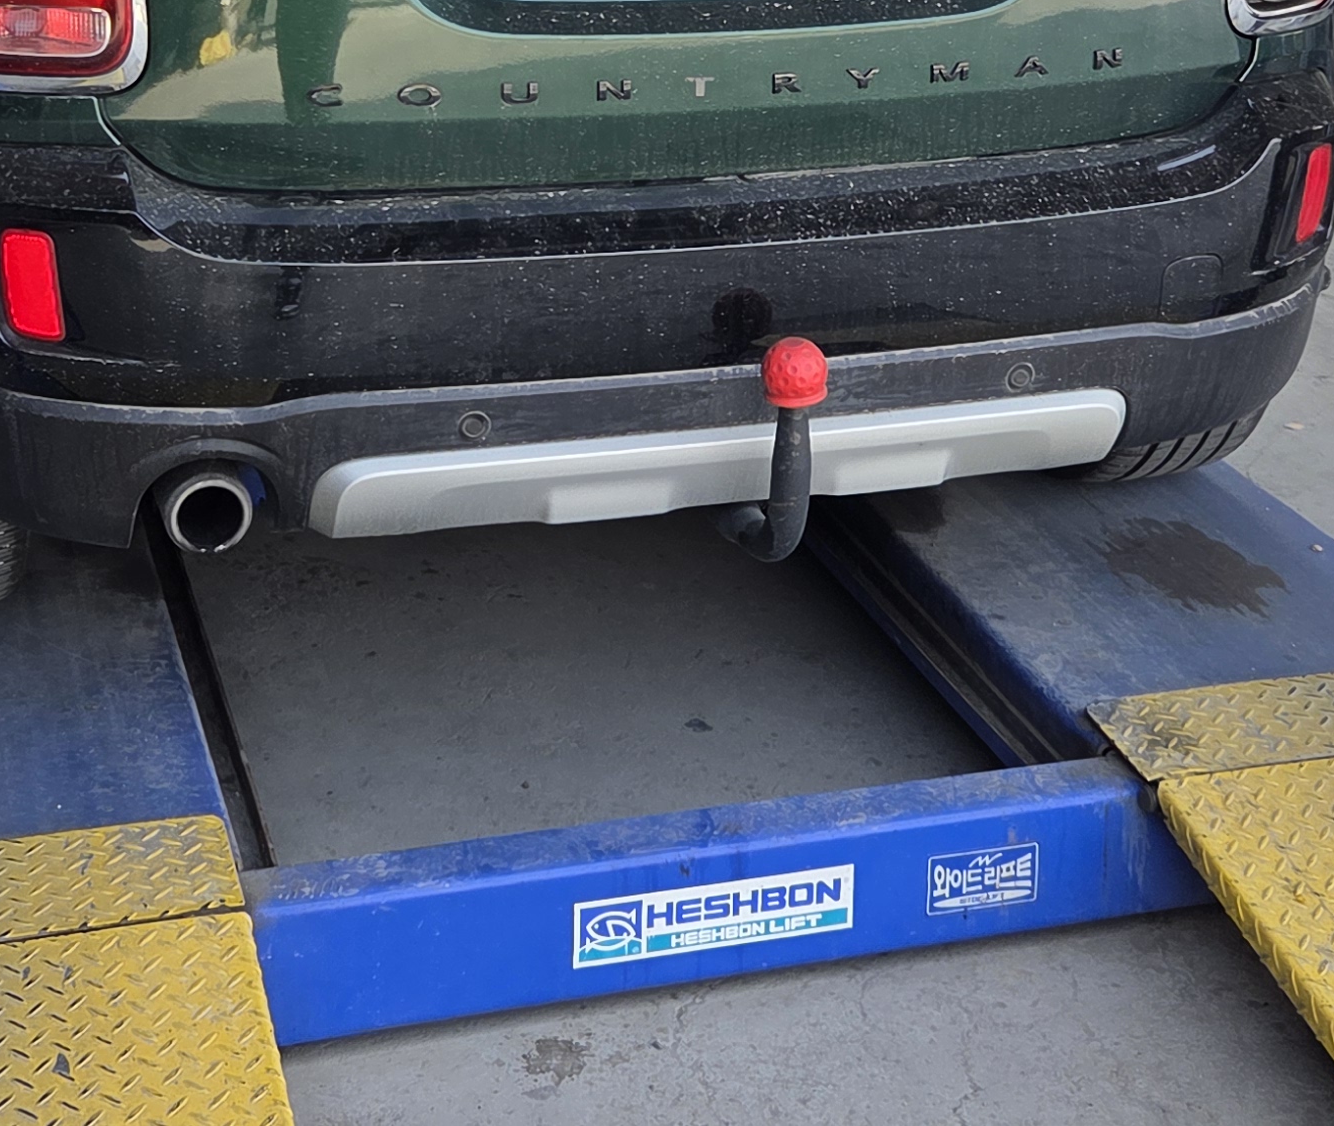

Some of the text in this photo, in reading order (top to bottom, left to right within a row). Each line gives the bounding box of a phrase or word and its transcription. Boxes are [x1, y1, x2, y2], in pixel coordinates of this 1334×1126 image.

[306, 47, 1123, 107] COUNTRYMAN
[932, 852, 1032, 899] 와이드리프트
[646, 877, 842, 930] HESHBON
[670, 913, 824, 948] HESHBON LIFT
